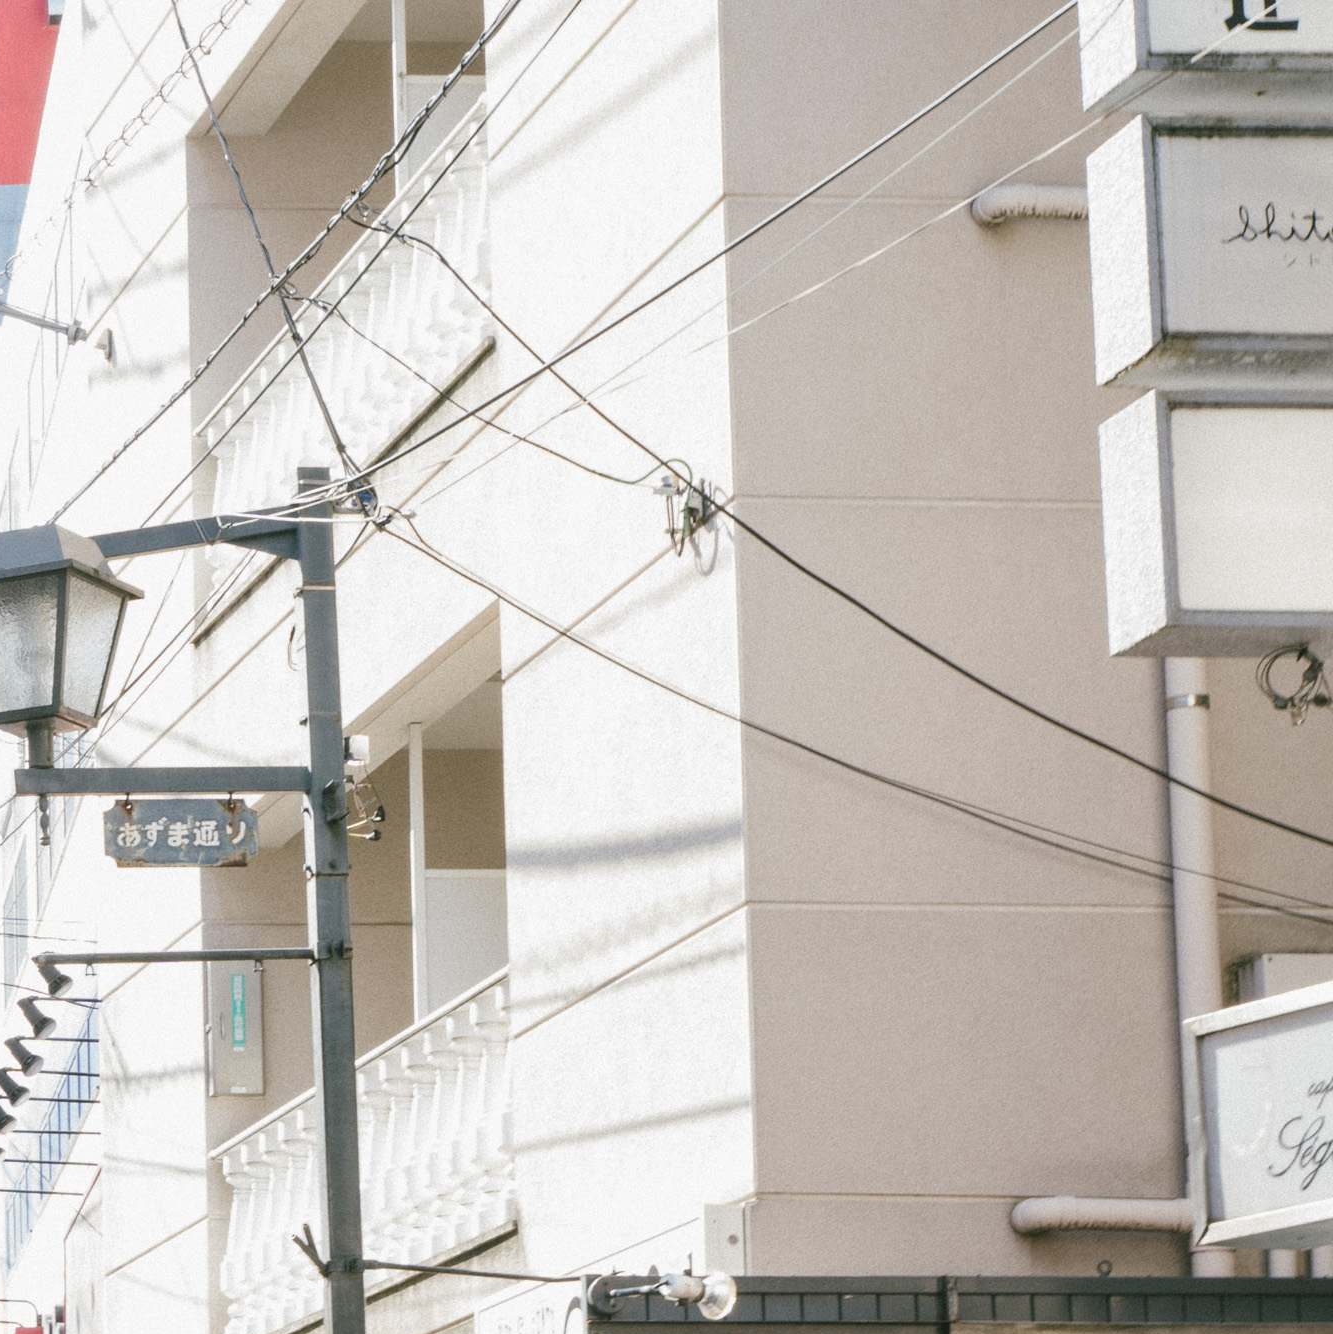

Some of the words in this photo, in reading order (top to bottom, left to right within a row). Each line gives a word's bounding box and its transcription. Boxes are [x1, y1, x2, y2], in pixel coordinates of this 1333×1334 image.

[116, 816, 247, 848] あずま通り
